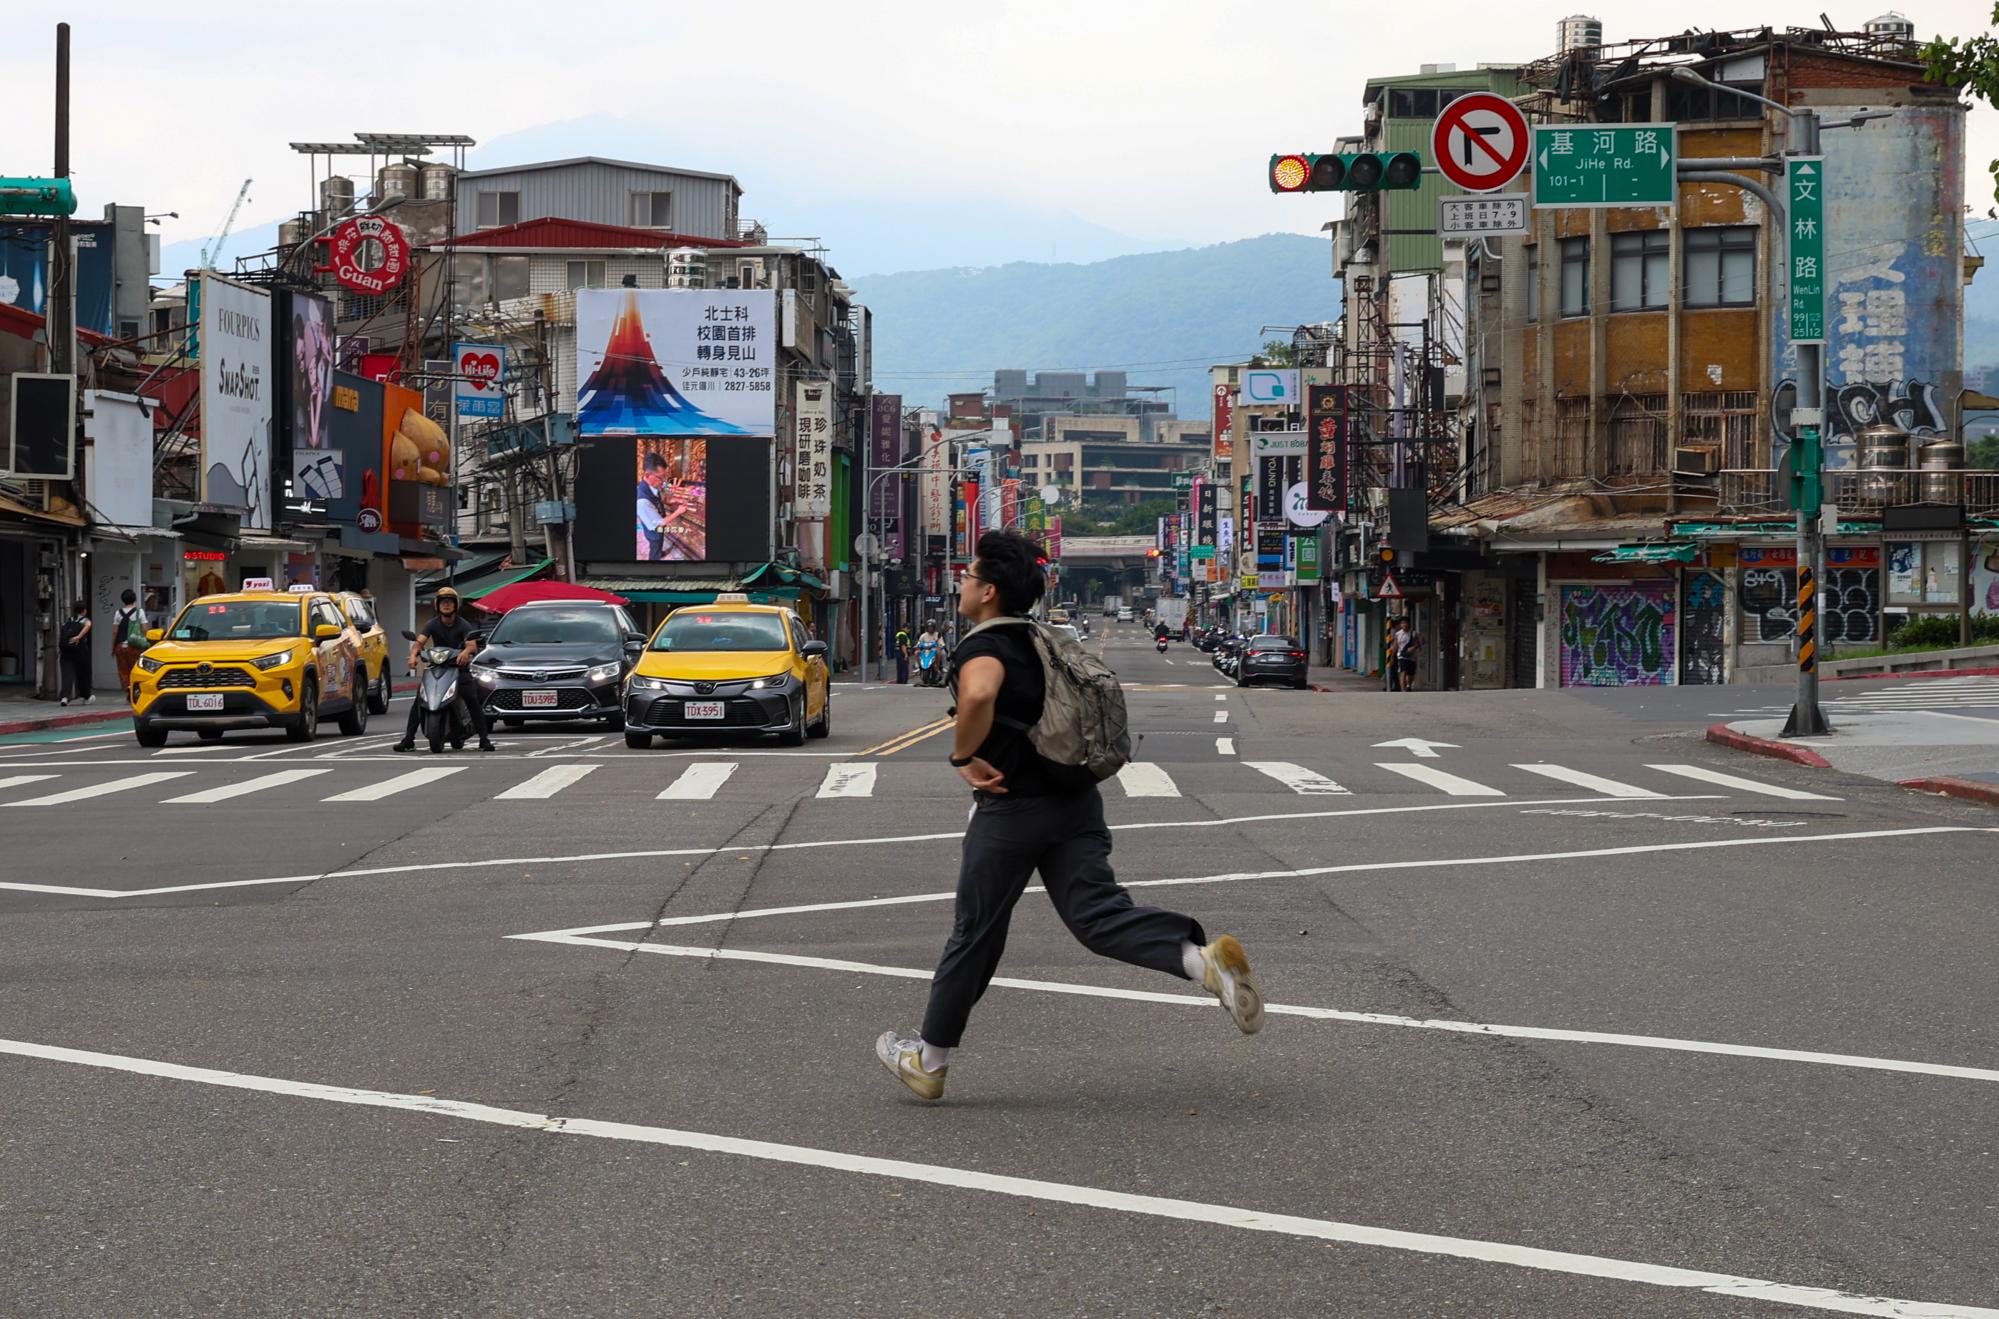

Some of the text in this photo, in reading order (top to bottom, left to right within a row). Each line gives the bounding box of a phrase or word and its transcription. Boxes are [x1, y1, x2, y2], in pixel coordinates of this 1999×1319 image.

[1550, 130, 1658, 155] 基河路
[1575, 158, 1606, 170] JiHe
[1449, 202, 1516, 212] 大客車除外
[1450, 220, 1516, 230] 小客車除外
[1794, 178, 1817, 279] 文林路
[339, 265, 383, 291] Guan
[1793, 285, 1821, 295] WenLin
[704, 305, 749, 322] 北士科
[1793, 313, 1806, 322] 99
[218, 307, 261, 342] FOURPICS
[696, 325, 757, 342] 校園首排
[1793, 329, 1822, 338] 25 12
[696, 345, 757, 361] 轉身見山
[464, 361, 496, 378] Hi-Life
[724, 381, 772, 392] 2827-5858
[458, 399, 501, 415] 萊爾富
[1270, 440, 1289, 449] JUST
[798, 417, 812, 499] 現研磨咖啡
[813, 417, 828, 499] 珍珠奶茶
[686, 706, 723, 718] TDX-3951
